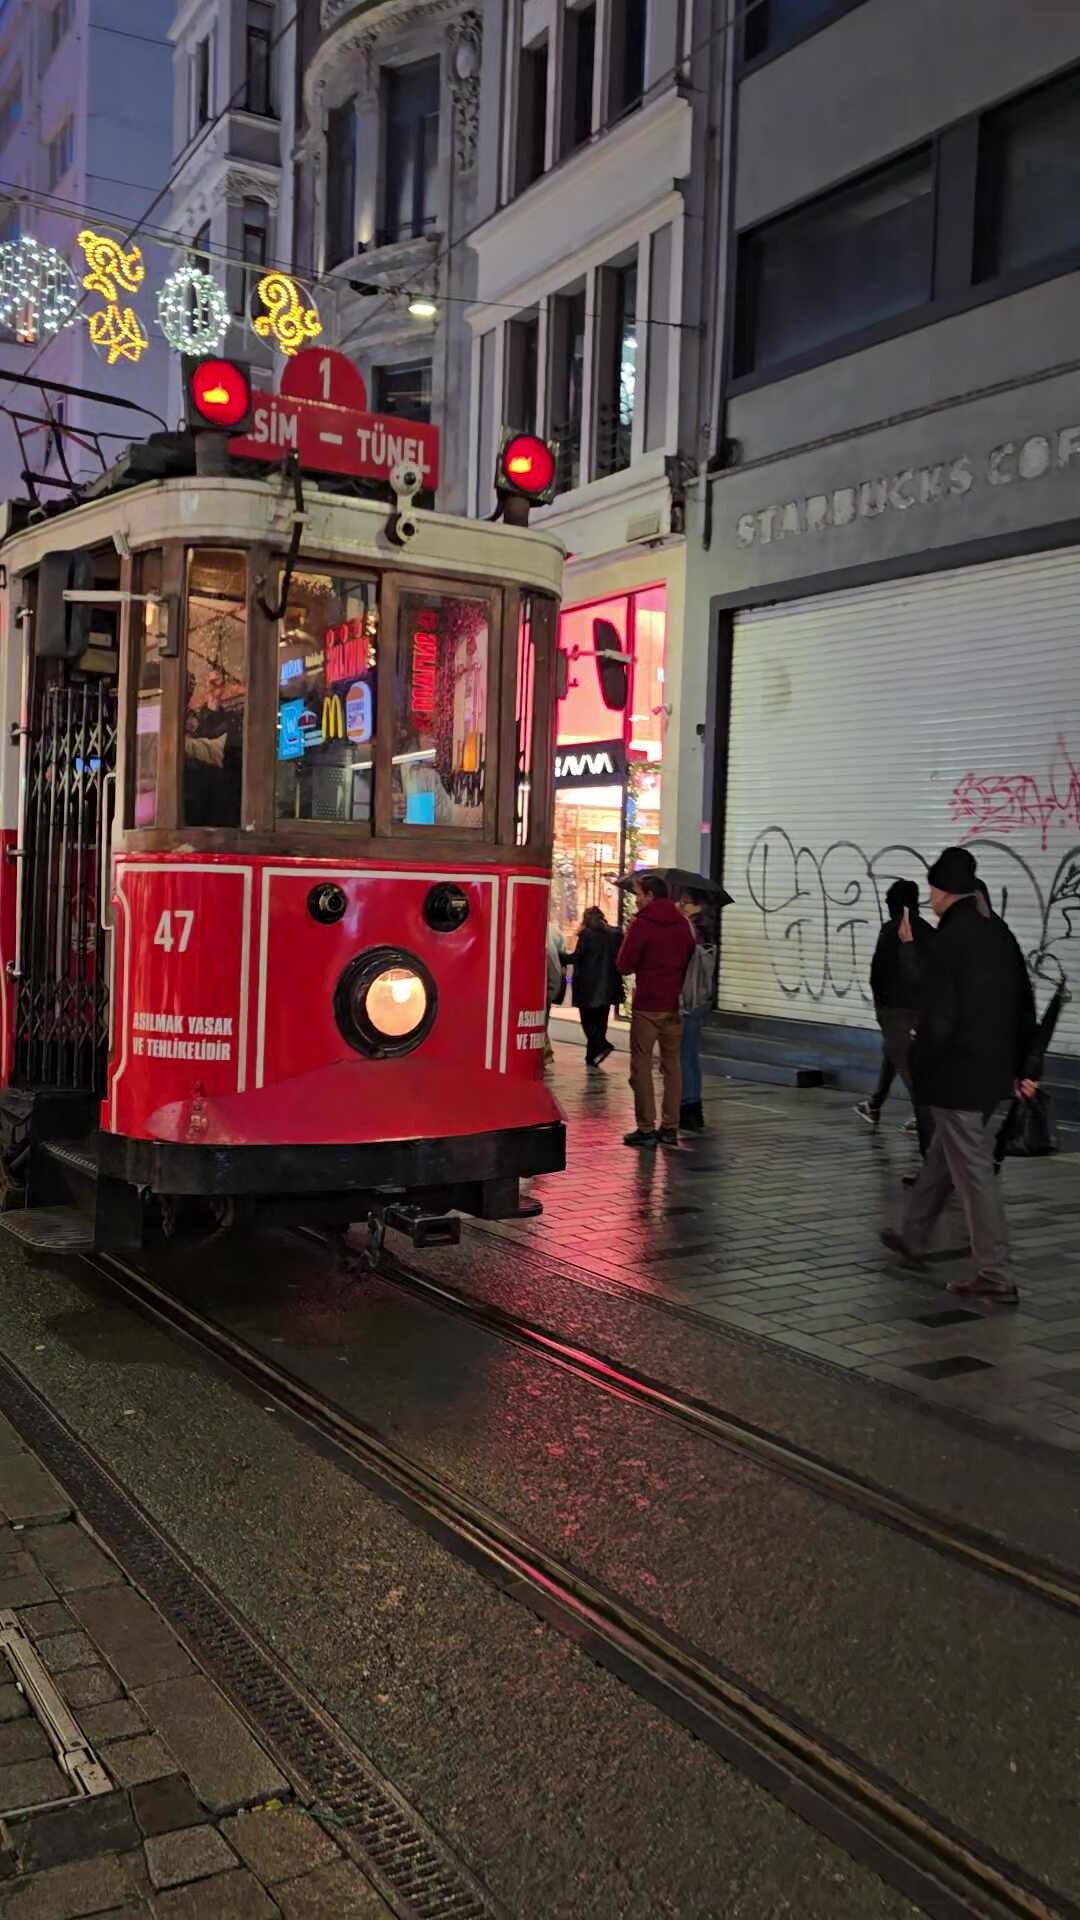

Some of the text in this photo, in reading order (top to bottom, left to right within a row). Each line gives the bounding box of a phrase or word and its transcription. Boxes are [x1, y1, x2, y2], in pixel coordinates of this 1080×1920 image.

[319, 356, 332, 401] 1
[248, 402, 298, 449] SİM
[356, 423, 431, 475] TÜNEL
[735, 454, 973, 549] STARBUCKS
[153, 909, 195, 953] 47
[132, 1011, 233, 1035] ASILMAK YASAK
[132, 1036, 231, 1061] VE TEHLİKELİDİR
